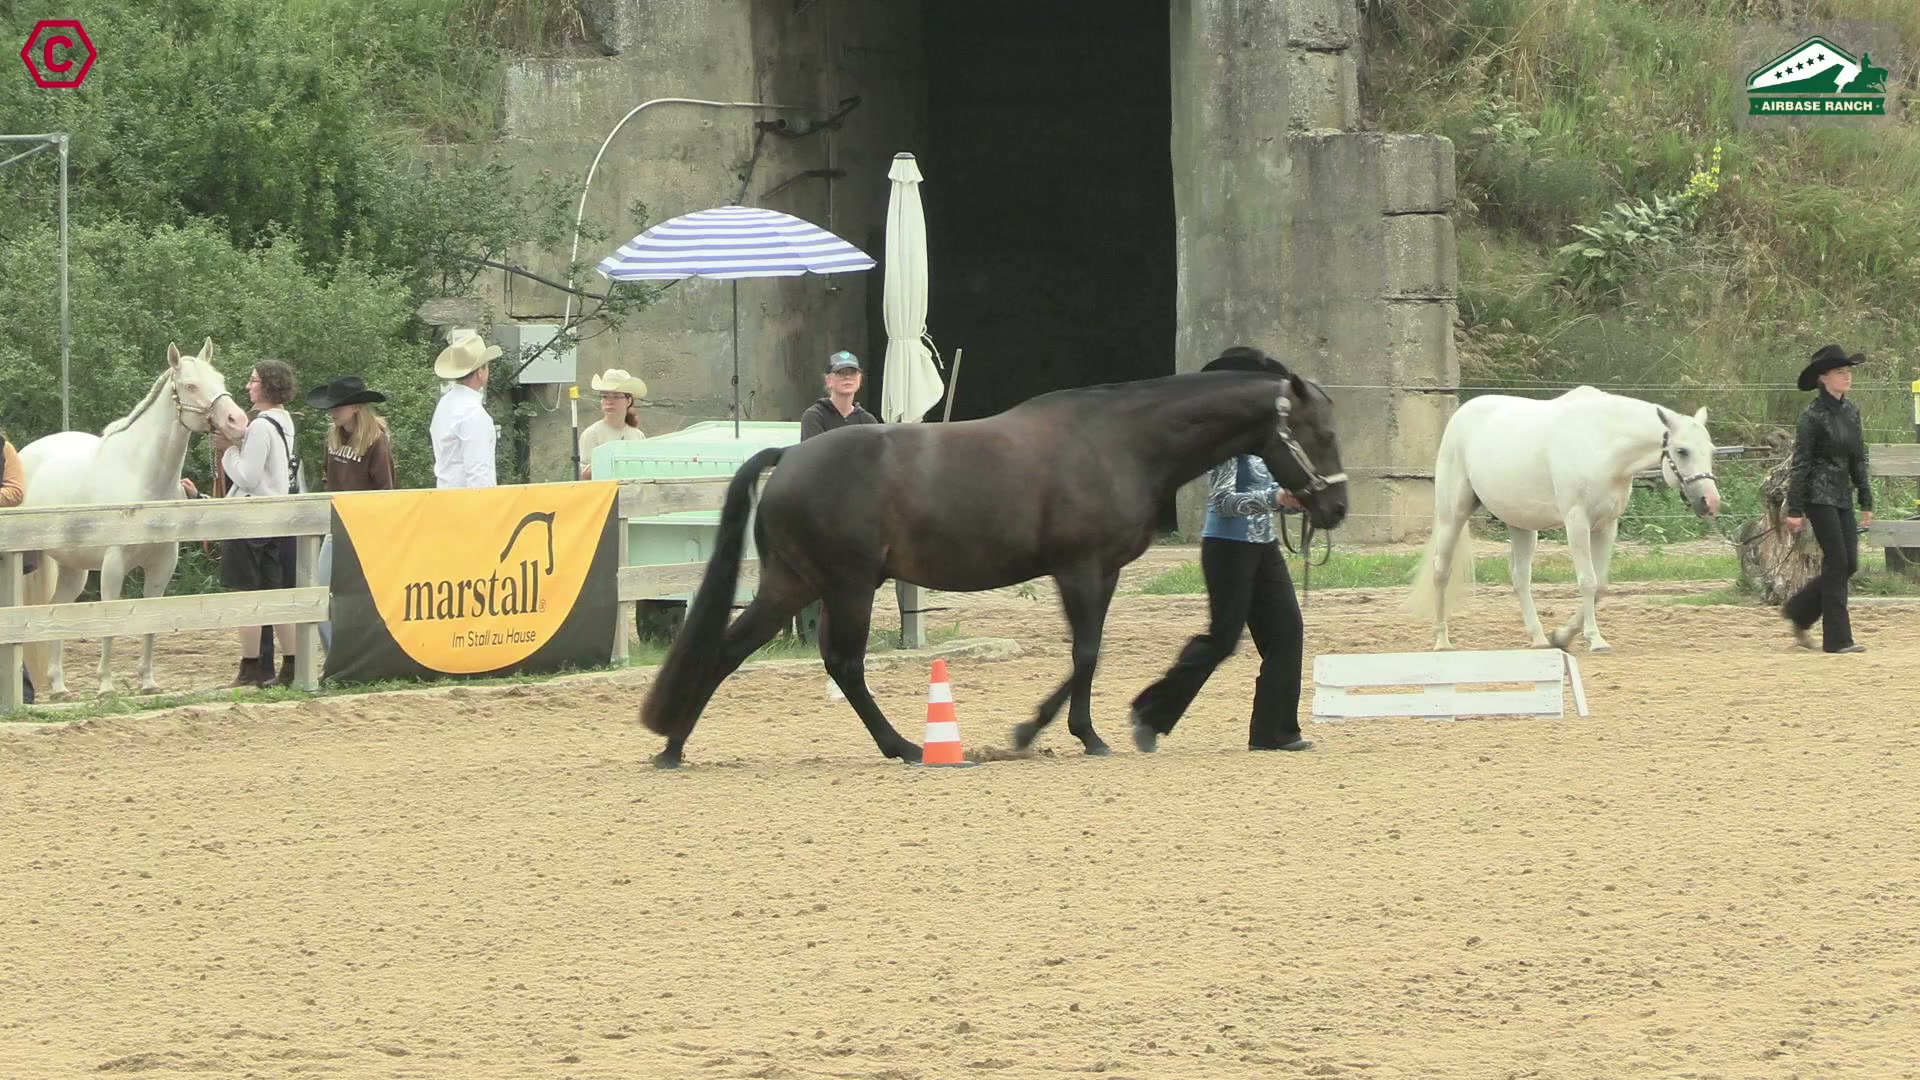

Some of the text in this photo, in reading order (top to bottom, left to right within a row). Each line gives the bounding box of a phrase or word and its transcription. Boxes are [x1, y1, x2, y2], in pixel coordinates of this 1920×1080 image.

[402, 559, 539, 622] marstall
[452, 627, 536, 648] Im Stall zu Hause
